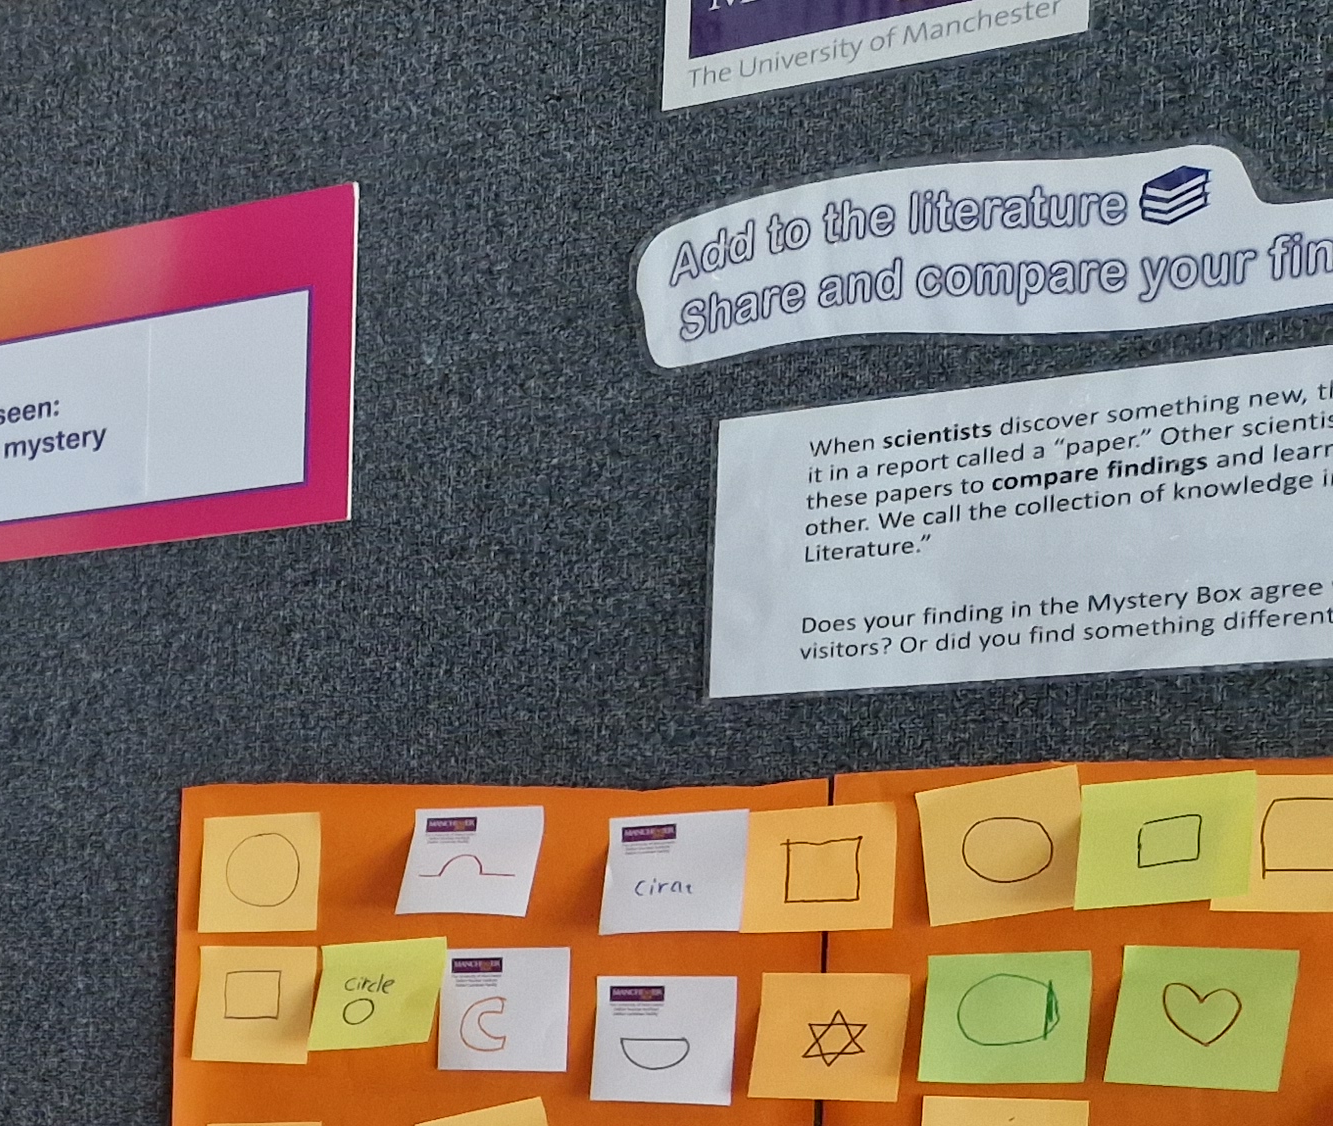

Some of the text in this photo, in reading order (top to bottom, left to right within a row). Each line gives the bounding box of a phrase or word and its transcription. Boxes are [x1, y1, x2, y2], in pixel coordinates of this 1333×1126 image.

[688, 1, 1062, 89] The University of Manchester
[669, 184, 1128, 287] Add to the literature
[679, 281, 807, 342] Share
[817, 256, 904, 308] and
[915, 257, 1128, 305] compare
[1138, 249, 1257, 303] your
[4, 427, 108, 461] mystery
[808, 466, 822, 484] it
[829, 465, 849, 481] in
[856, 465, 869, 479] a
[876, 453, 950, 478] report
[956, 443, 1025, 469] called
[1032, 445, 1045, 460] a
[1160, 423, 1235, 447] Other
[810, 388, 1308, 457] When scientists discover something new,
[805, 472, 1314, 537] other. We call the collection of knowledge
[806, 491, 868, 511] these
[875, 481, 953, 508] papers
[960, 478, 984, 495] to
[991, 466, 1099, 492] compare
[1107, 454, 1208, 480] findings
[1216, 445, 1264, 469] and
[800, 637, 892, 660] visitors?
[900, 635, 929, 654] Or
[935, 631, 972, 652] did
[978, 631, 1021, 653] you
[1029, 623, 1075, 645] find
[1083, 615, 1216, 641] something
[801, 581, 1324, 634] Does your finding in the Mystery Box agree
